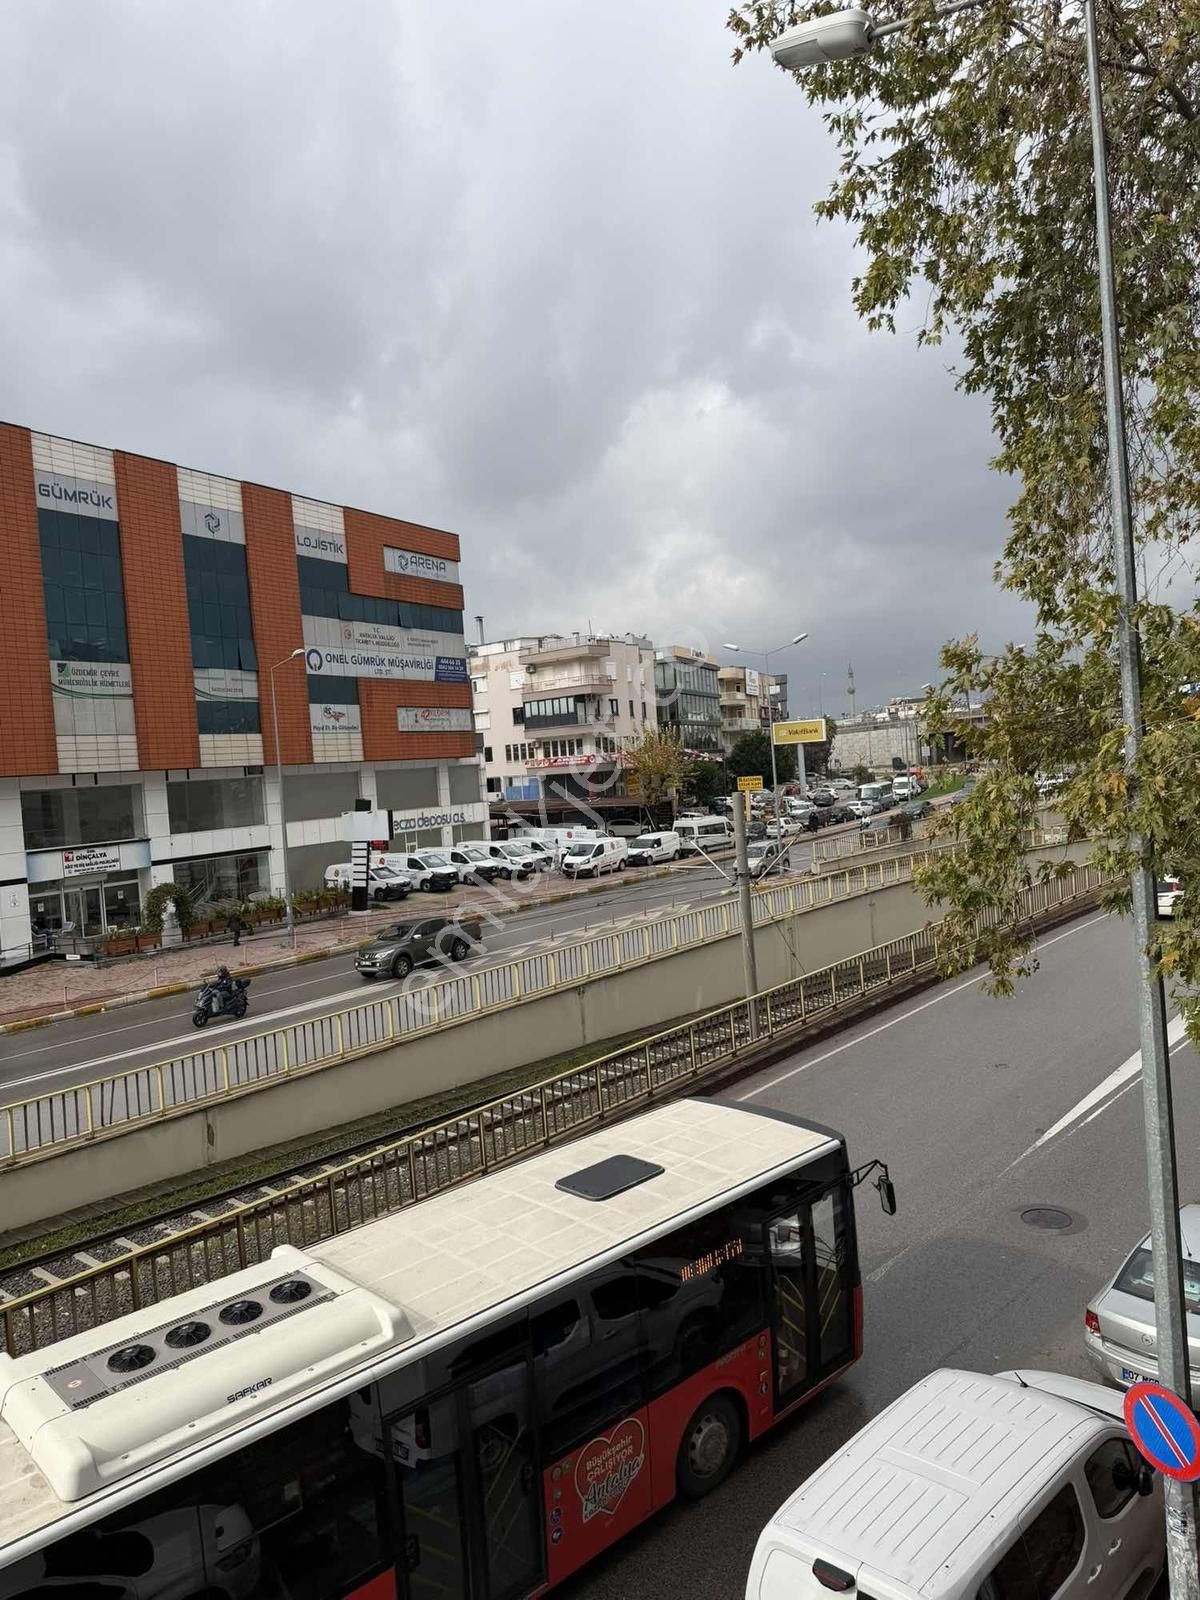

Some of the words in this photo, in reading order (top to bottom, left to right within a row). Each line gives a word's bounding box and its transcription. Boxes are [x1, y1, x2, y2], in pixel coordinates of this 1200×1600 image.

[38, 482, 112, 509] GÜMRÜK
[296, 535, 344, 554] LOJİSTİK
[409, 555, 446, 573] ARENA
[351, 654, 386, 667] GÜMRÜK
[388, 657, 434, 671] MÜŞAVİRLİĞİ
[100, 669, 121, 678] ÇEVRE
[393, 818, 416, 831] ecza
[417, 811, 452, 828] deposu
[76, 852, 107, 860] DİNÇALYA
[1129, 1370, 1140, 1381] 07
[226, 1377, 272, 1404] SAFKAR
[586, 1435, 633, 1470] Büyükşehir
[587, 1445, 633, 1482] ÇALIŞIYOR
[584, 1454, 645, 1503] Antalya
